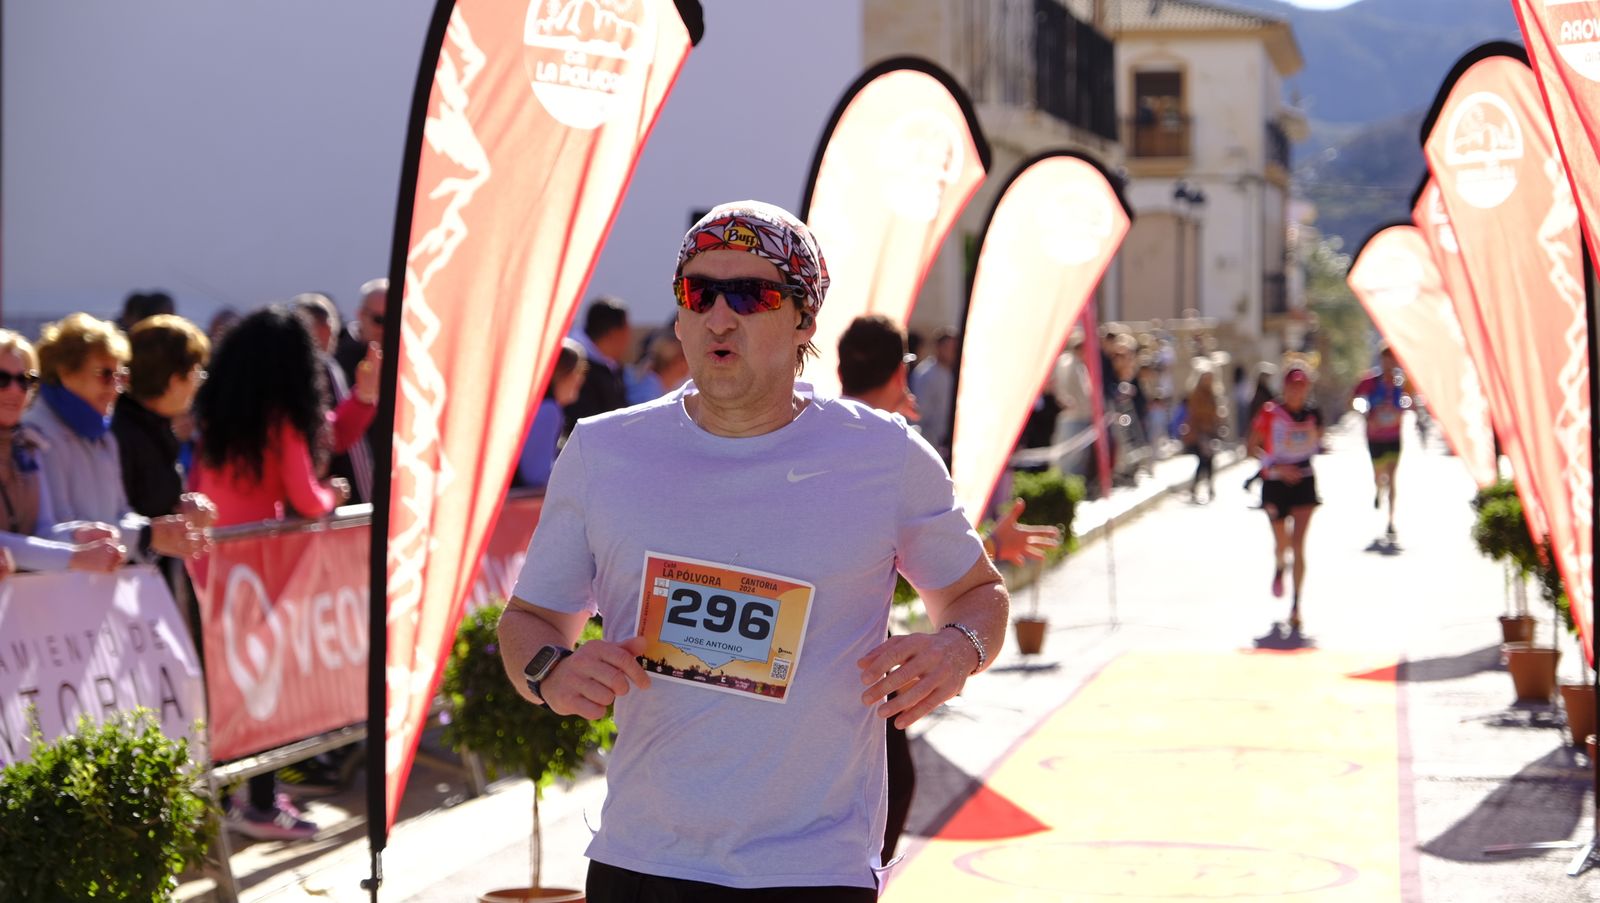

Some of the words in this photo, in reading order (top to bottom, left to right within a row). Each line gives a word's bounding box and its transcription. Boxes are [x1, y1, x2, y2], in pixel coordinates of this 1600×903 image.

[728, 229, 756, 246] Buff
[662, 568, 674, 578] LA
[676, 569, 721, 586] PÓLVORA
[740, 576, 778, 591] CANTORIA
[739, 585, 756, 593] 2024
[667, 588, 774, 640] 296
[683, 635, 704, 646] JOSE
[705, 640, 743, 653] ANTONIO
